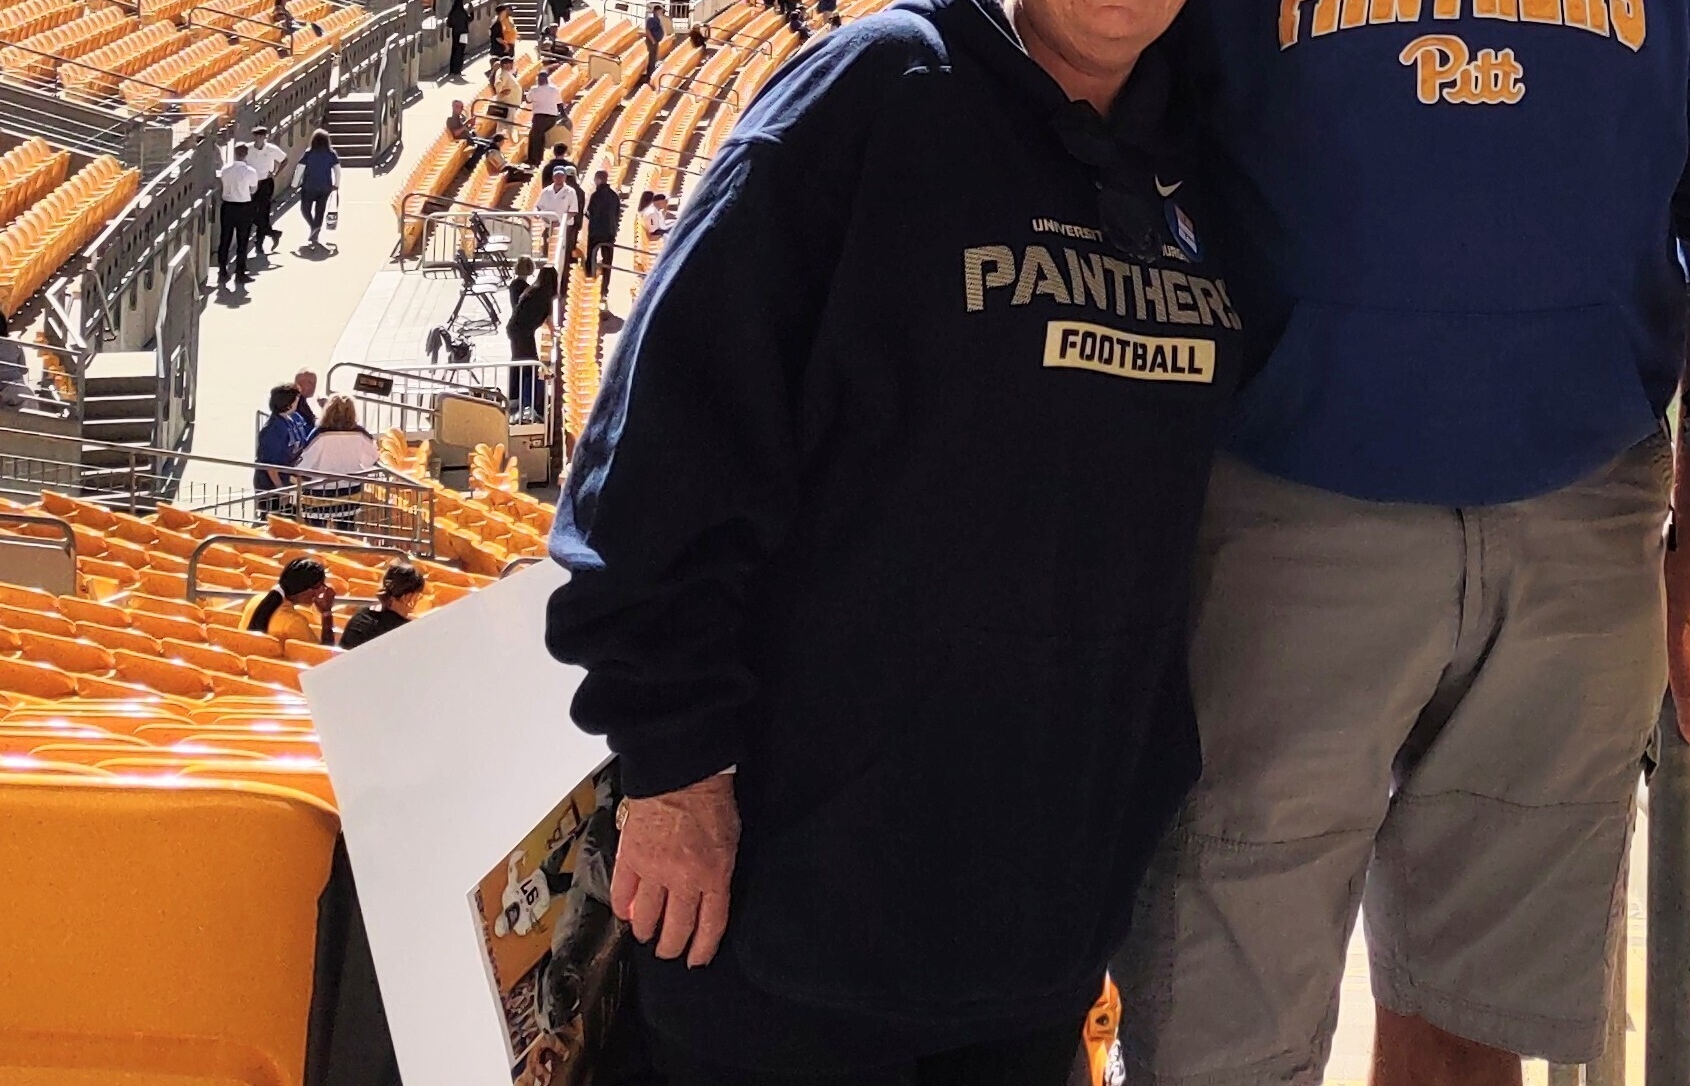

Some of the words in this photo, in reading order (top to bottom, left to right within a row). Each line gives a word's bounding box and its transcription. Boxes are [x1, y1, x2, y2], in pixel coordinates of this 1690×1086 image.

[1399, 34, 1526, 105] Pitt
[1031, 218, 1104, 243] UNIVERSIT
[1058, 328, 1204, 375] FOOTBALL
